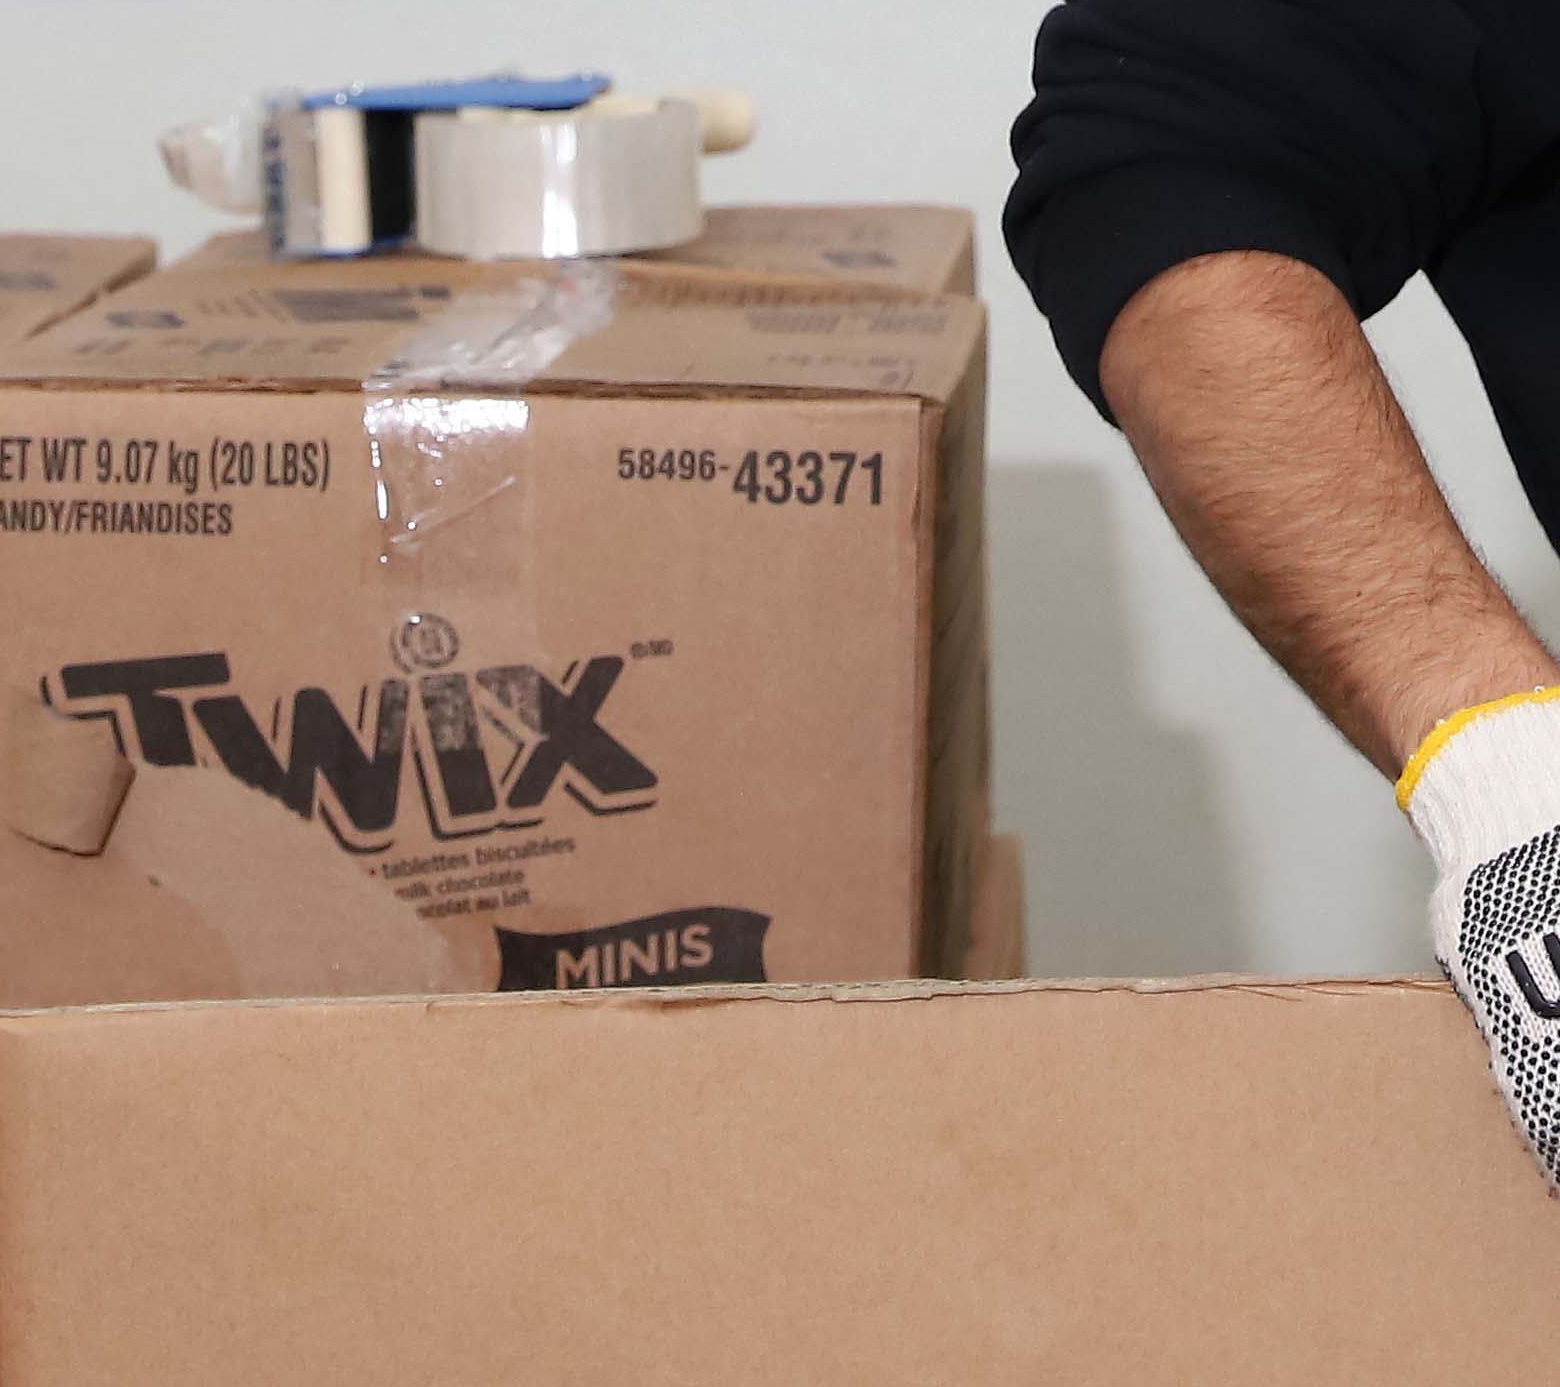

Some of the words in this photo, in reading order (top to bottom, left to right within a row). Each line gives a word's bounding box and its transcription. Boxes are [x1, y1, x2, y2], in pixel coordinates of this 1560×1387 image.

[41, 437, 87, 484] WT
[95, 439, 158, 485] 9.07
[167, 440, 201, 494] kg
[208, 436, 254, 492] (20
[263, 437, 330, 493] LBS)
[617, 447, 884, 506] 58496-43371
[554, 923, 715, 989] MINIS
